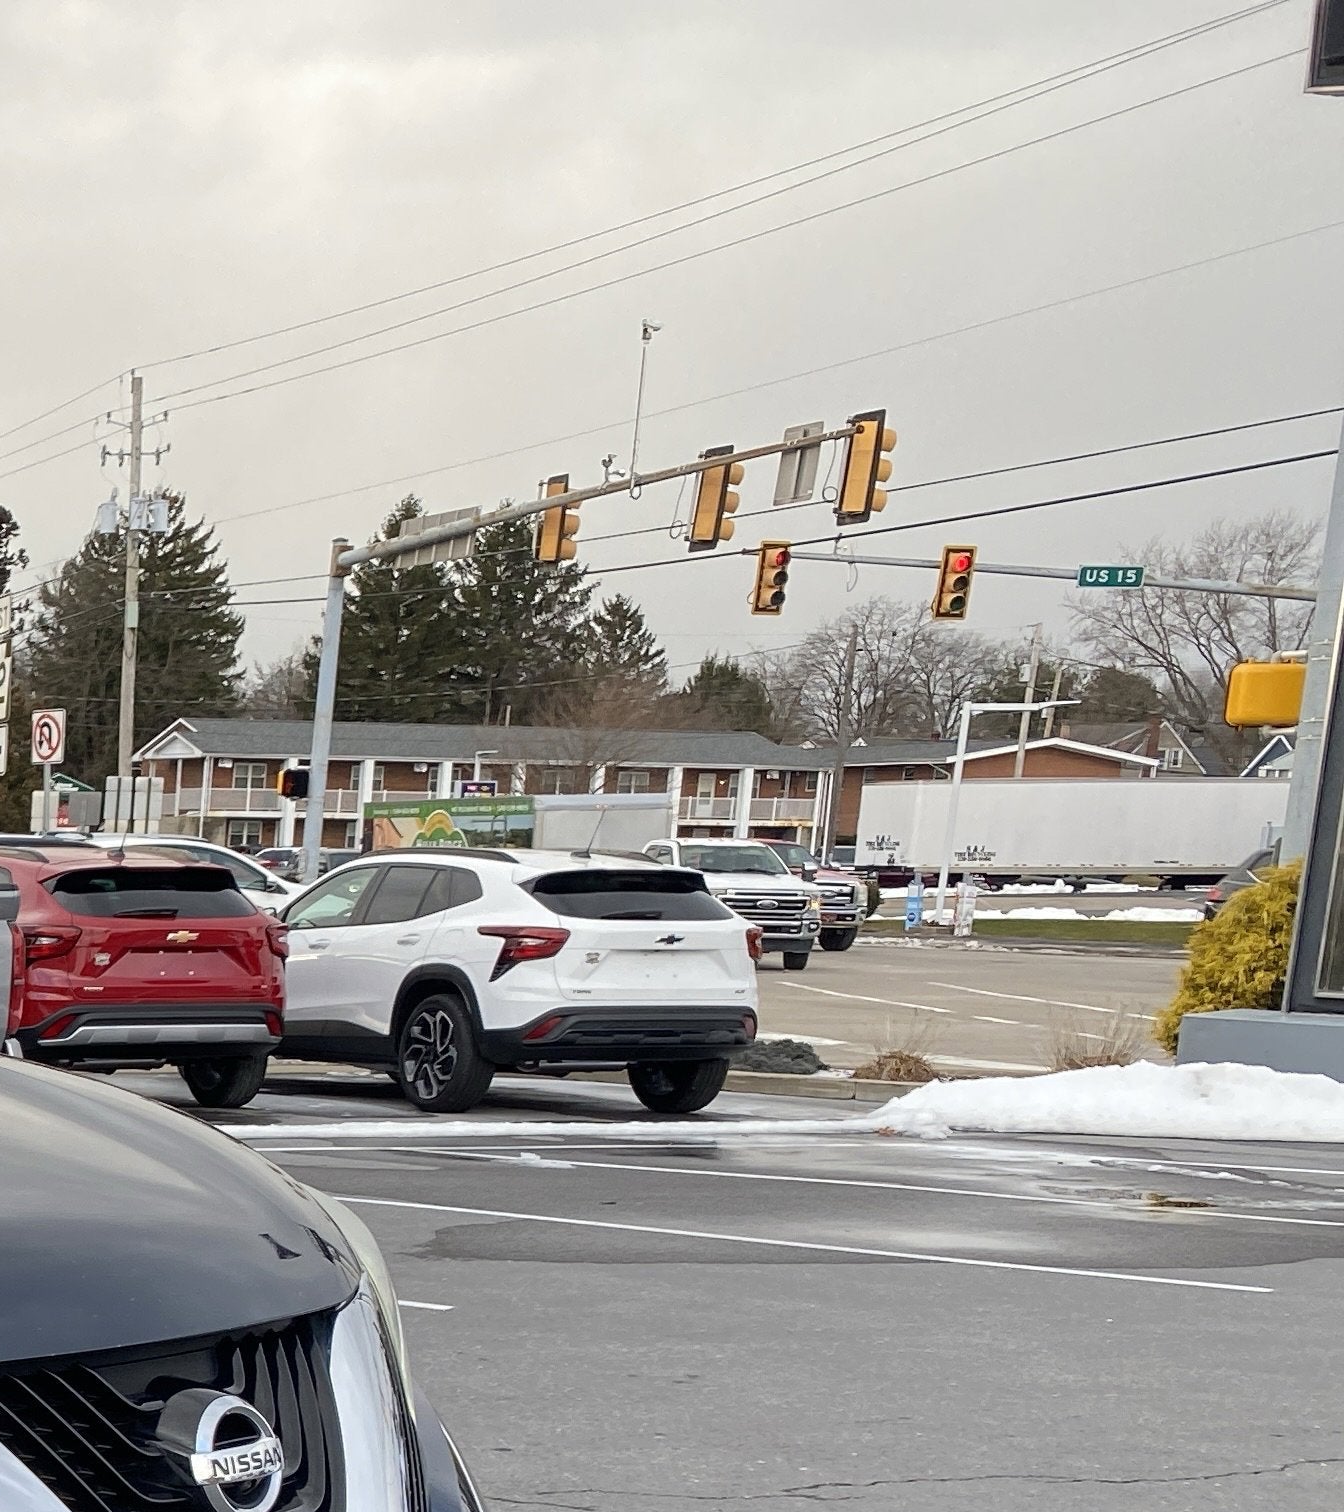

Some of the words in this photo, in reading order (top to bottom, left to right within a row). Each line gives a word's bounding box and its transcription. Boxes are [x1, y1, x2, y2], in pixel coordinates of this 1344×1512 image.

[1085, 569, 1109, 583] US
[1117, 569, 1137, 583] 15
[212, 1446, 282, 1478] NISSAN
